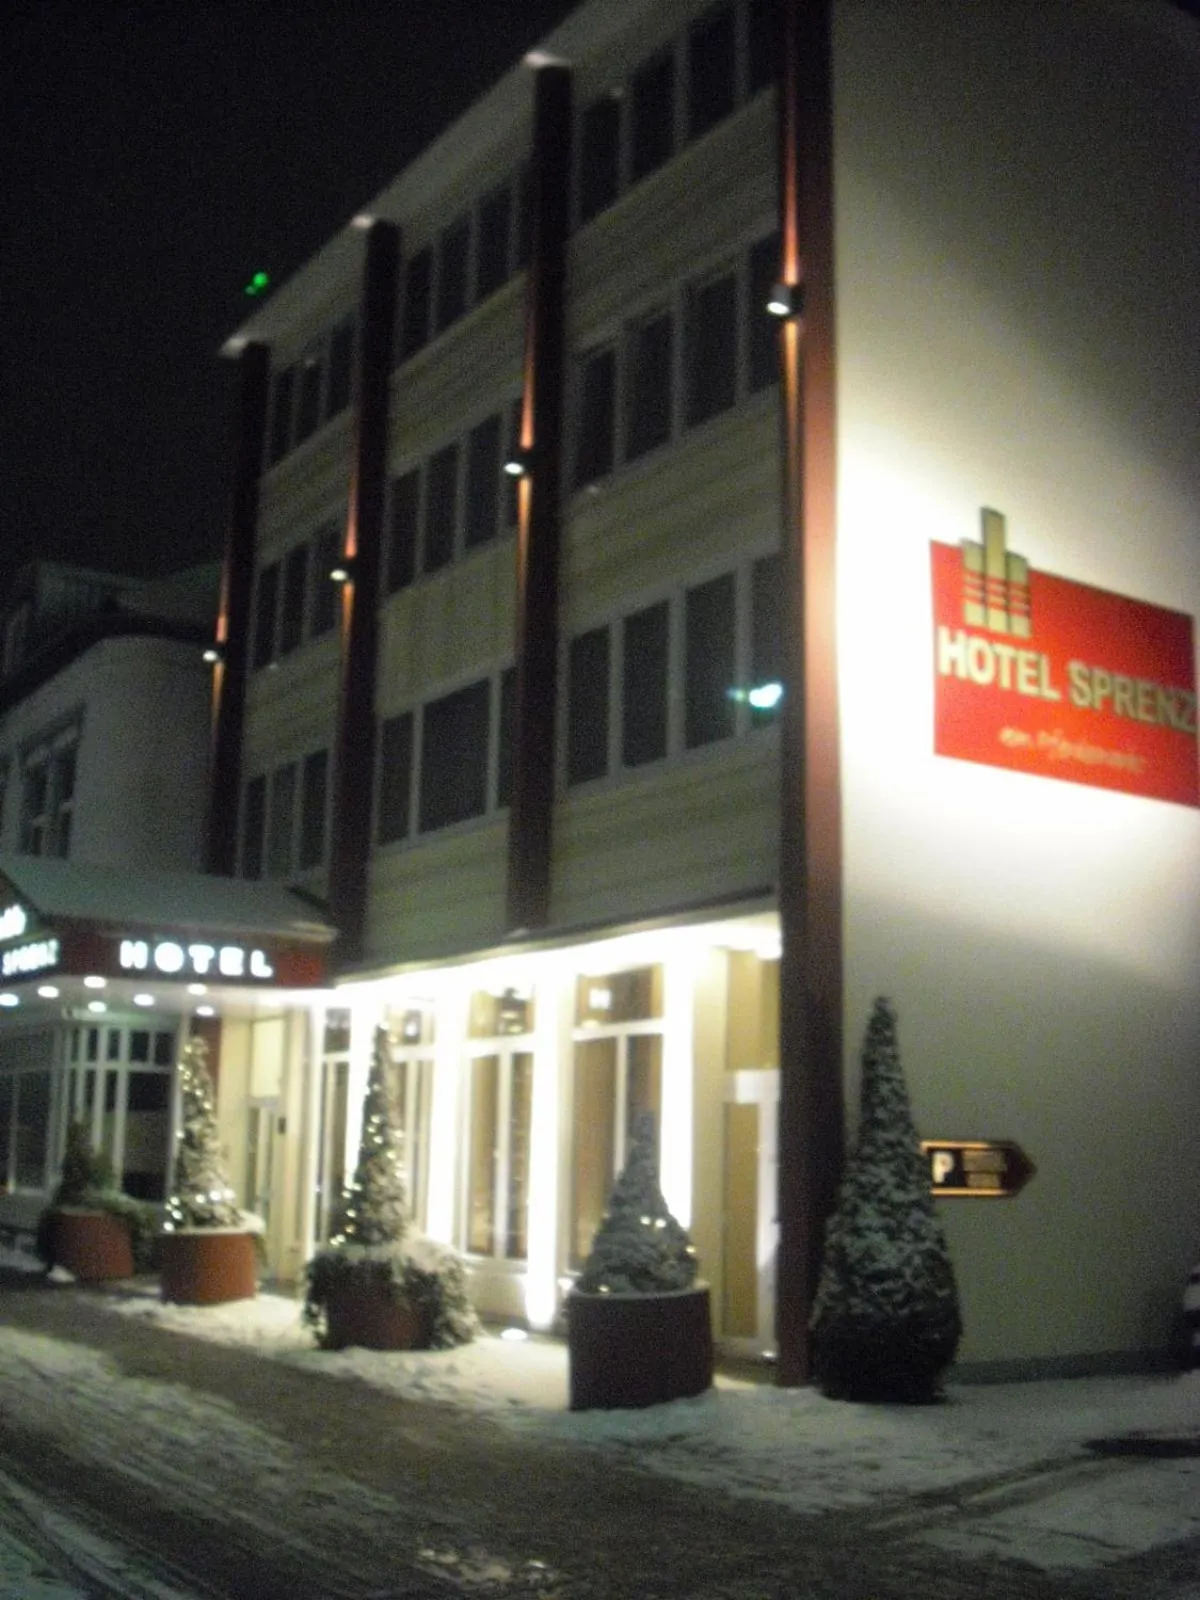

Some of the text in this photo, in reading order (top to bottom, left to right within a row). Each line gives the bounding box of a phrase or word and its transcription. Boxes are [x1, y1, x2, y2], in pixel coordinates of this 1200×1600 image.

[937, 627, 1061, 701] HOTEL
[119, 940, 273, 977] HOTEL
[932, 1151, 954, 1184] P
